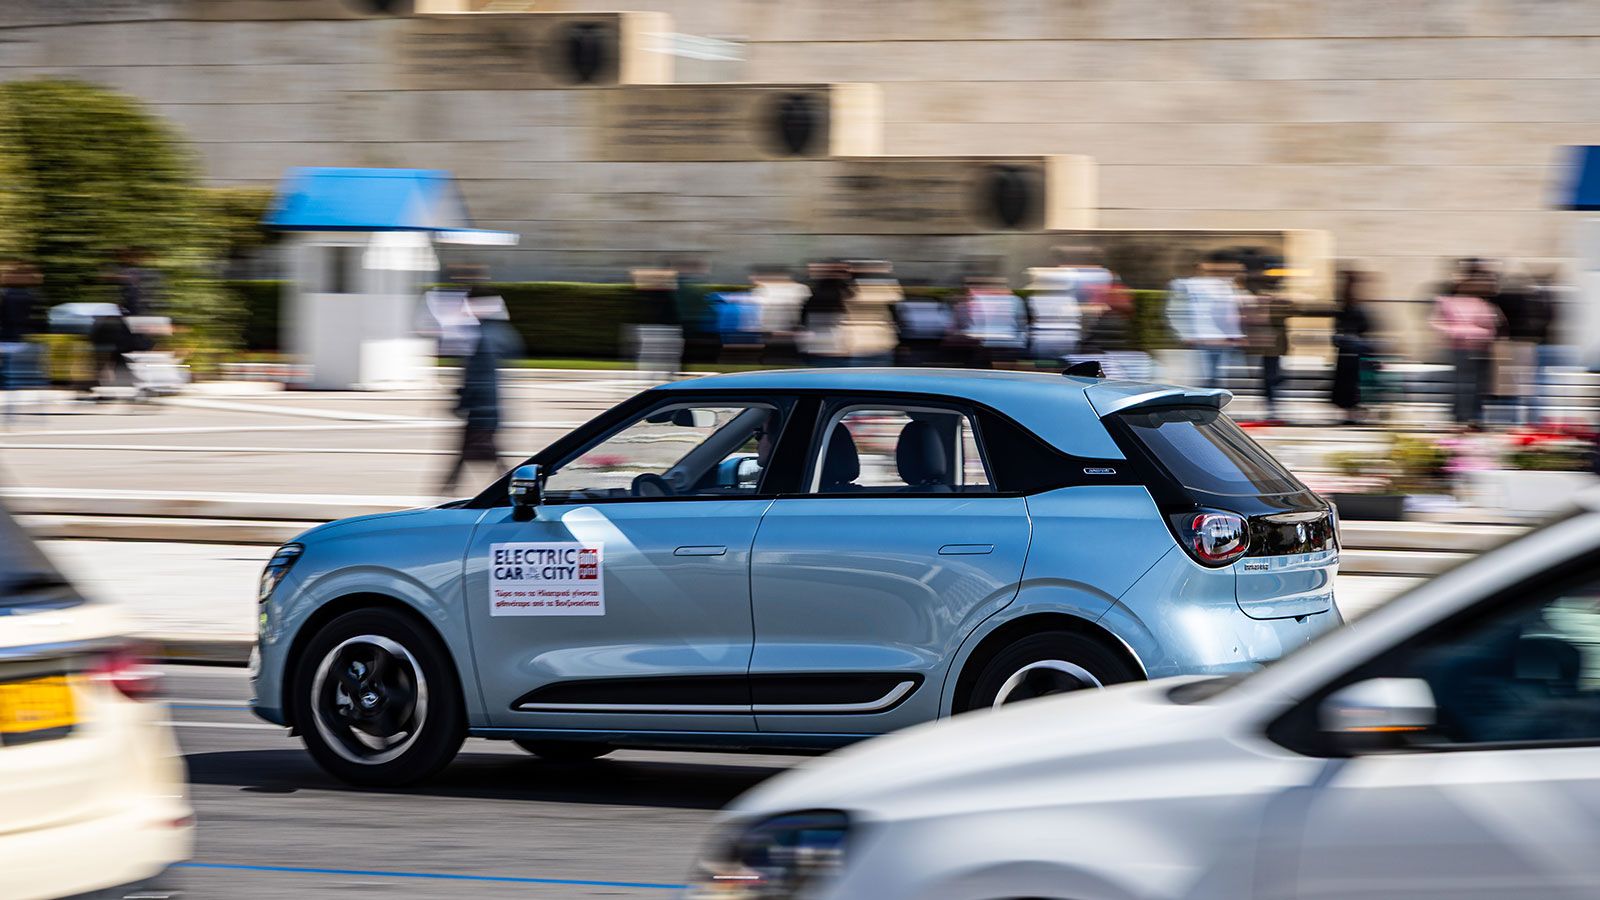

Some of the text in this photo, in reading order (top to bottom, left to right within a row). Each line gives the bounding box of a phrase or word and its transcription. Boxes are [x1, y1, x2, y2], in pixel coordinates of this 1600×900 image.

[495, 549, 576, 565] ELECTRIC
[494, 567, 524, 580] CAR
[542, 567, 575, 580] CITY
